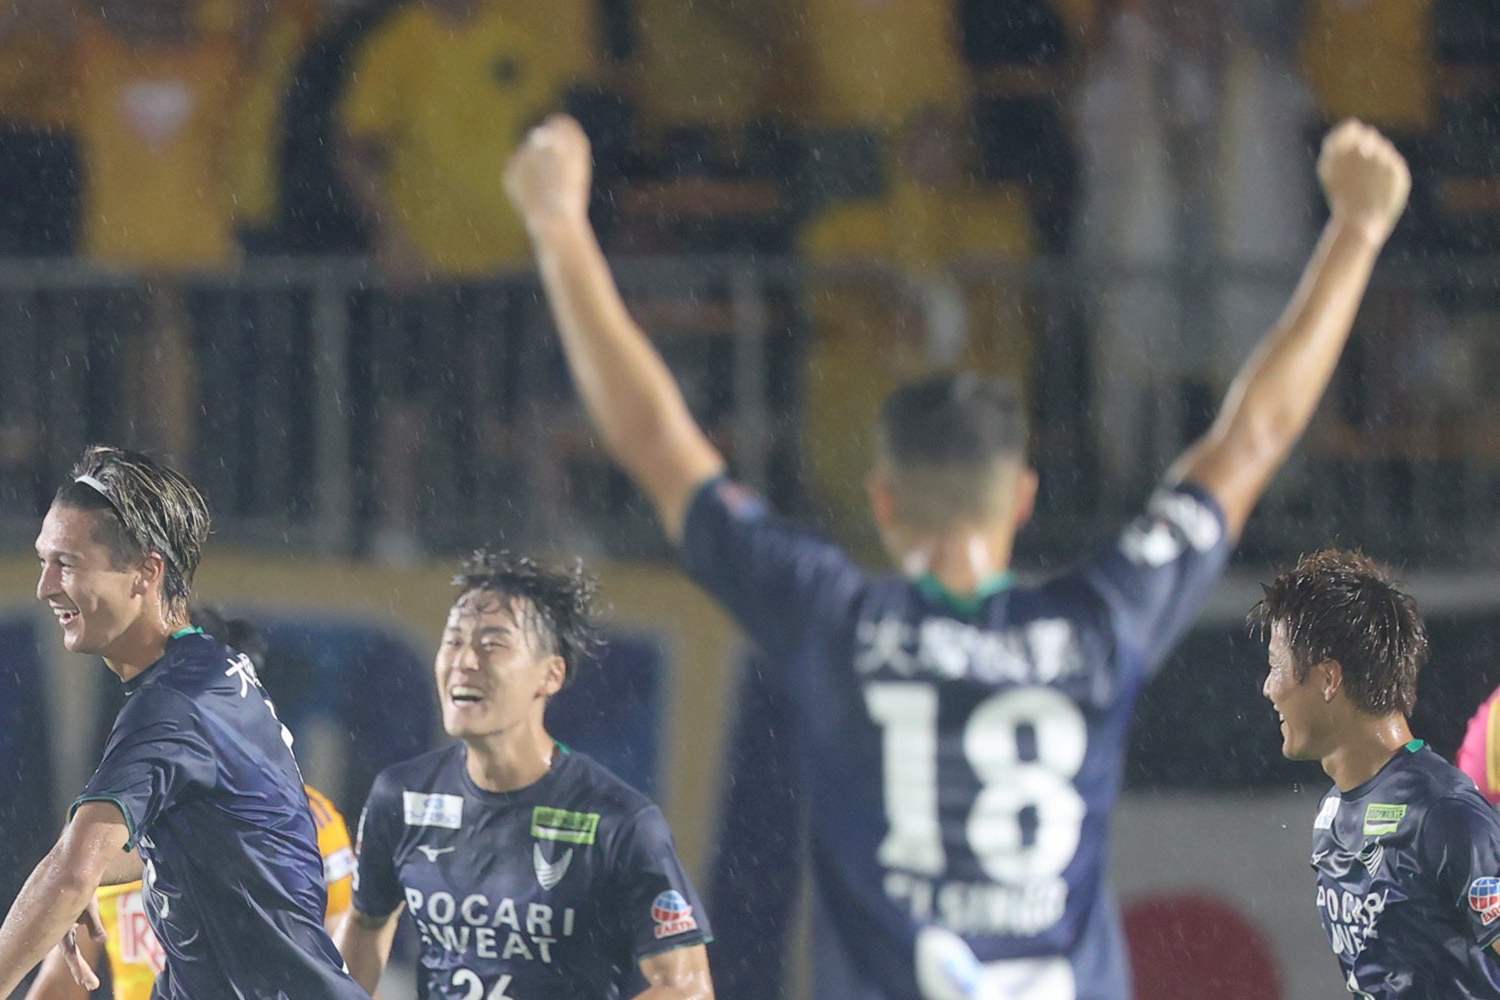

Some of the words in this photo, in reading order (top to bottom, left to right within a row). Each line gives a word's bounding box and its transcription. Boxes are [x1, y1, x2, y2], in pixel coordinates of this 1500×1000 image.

[863, 680, 1088, 886] 18
[404, 886, 575, 938] POCARI
[417, 918, 558, 964] SWEAT
